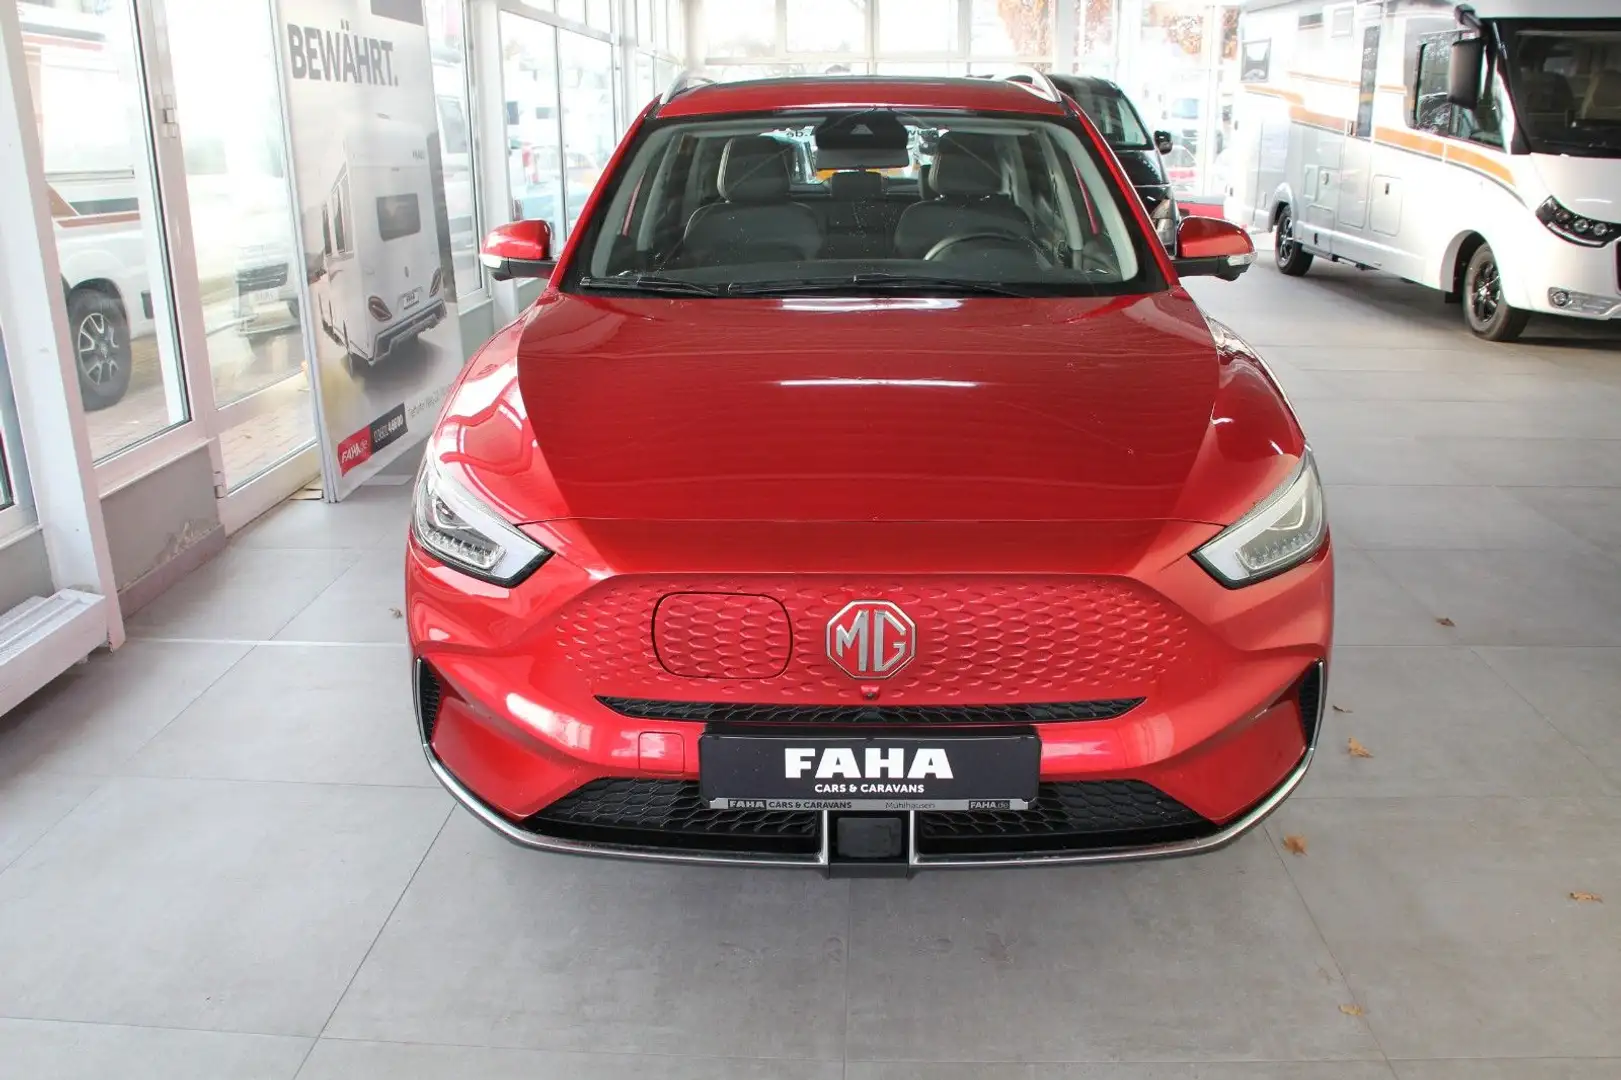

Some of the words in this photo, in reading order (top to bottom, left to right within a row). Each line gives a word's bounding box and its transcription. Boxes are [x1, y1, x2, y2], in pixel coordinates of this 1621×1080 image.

[287, 18, 399, 87] BEWÄHRT.
[836, 609, 906, 672] MG
[785, 748, 953, 778] FAHA
[814, 784, 846, 793] CARS
[849, 784, 857, 793] &
[861, 784, 925, 793] CARAVANS
[729, 801, 765, 809] FAHA
[768, 801, 793, 809] CARS
[795, 801, 802, 809] &
[804, 801, 852, 809] CARAVANS
[970, 801, 1010, 809] FAHA.de
